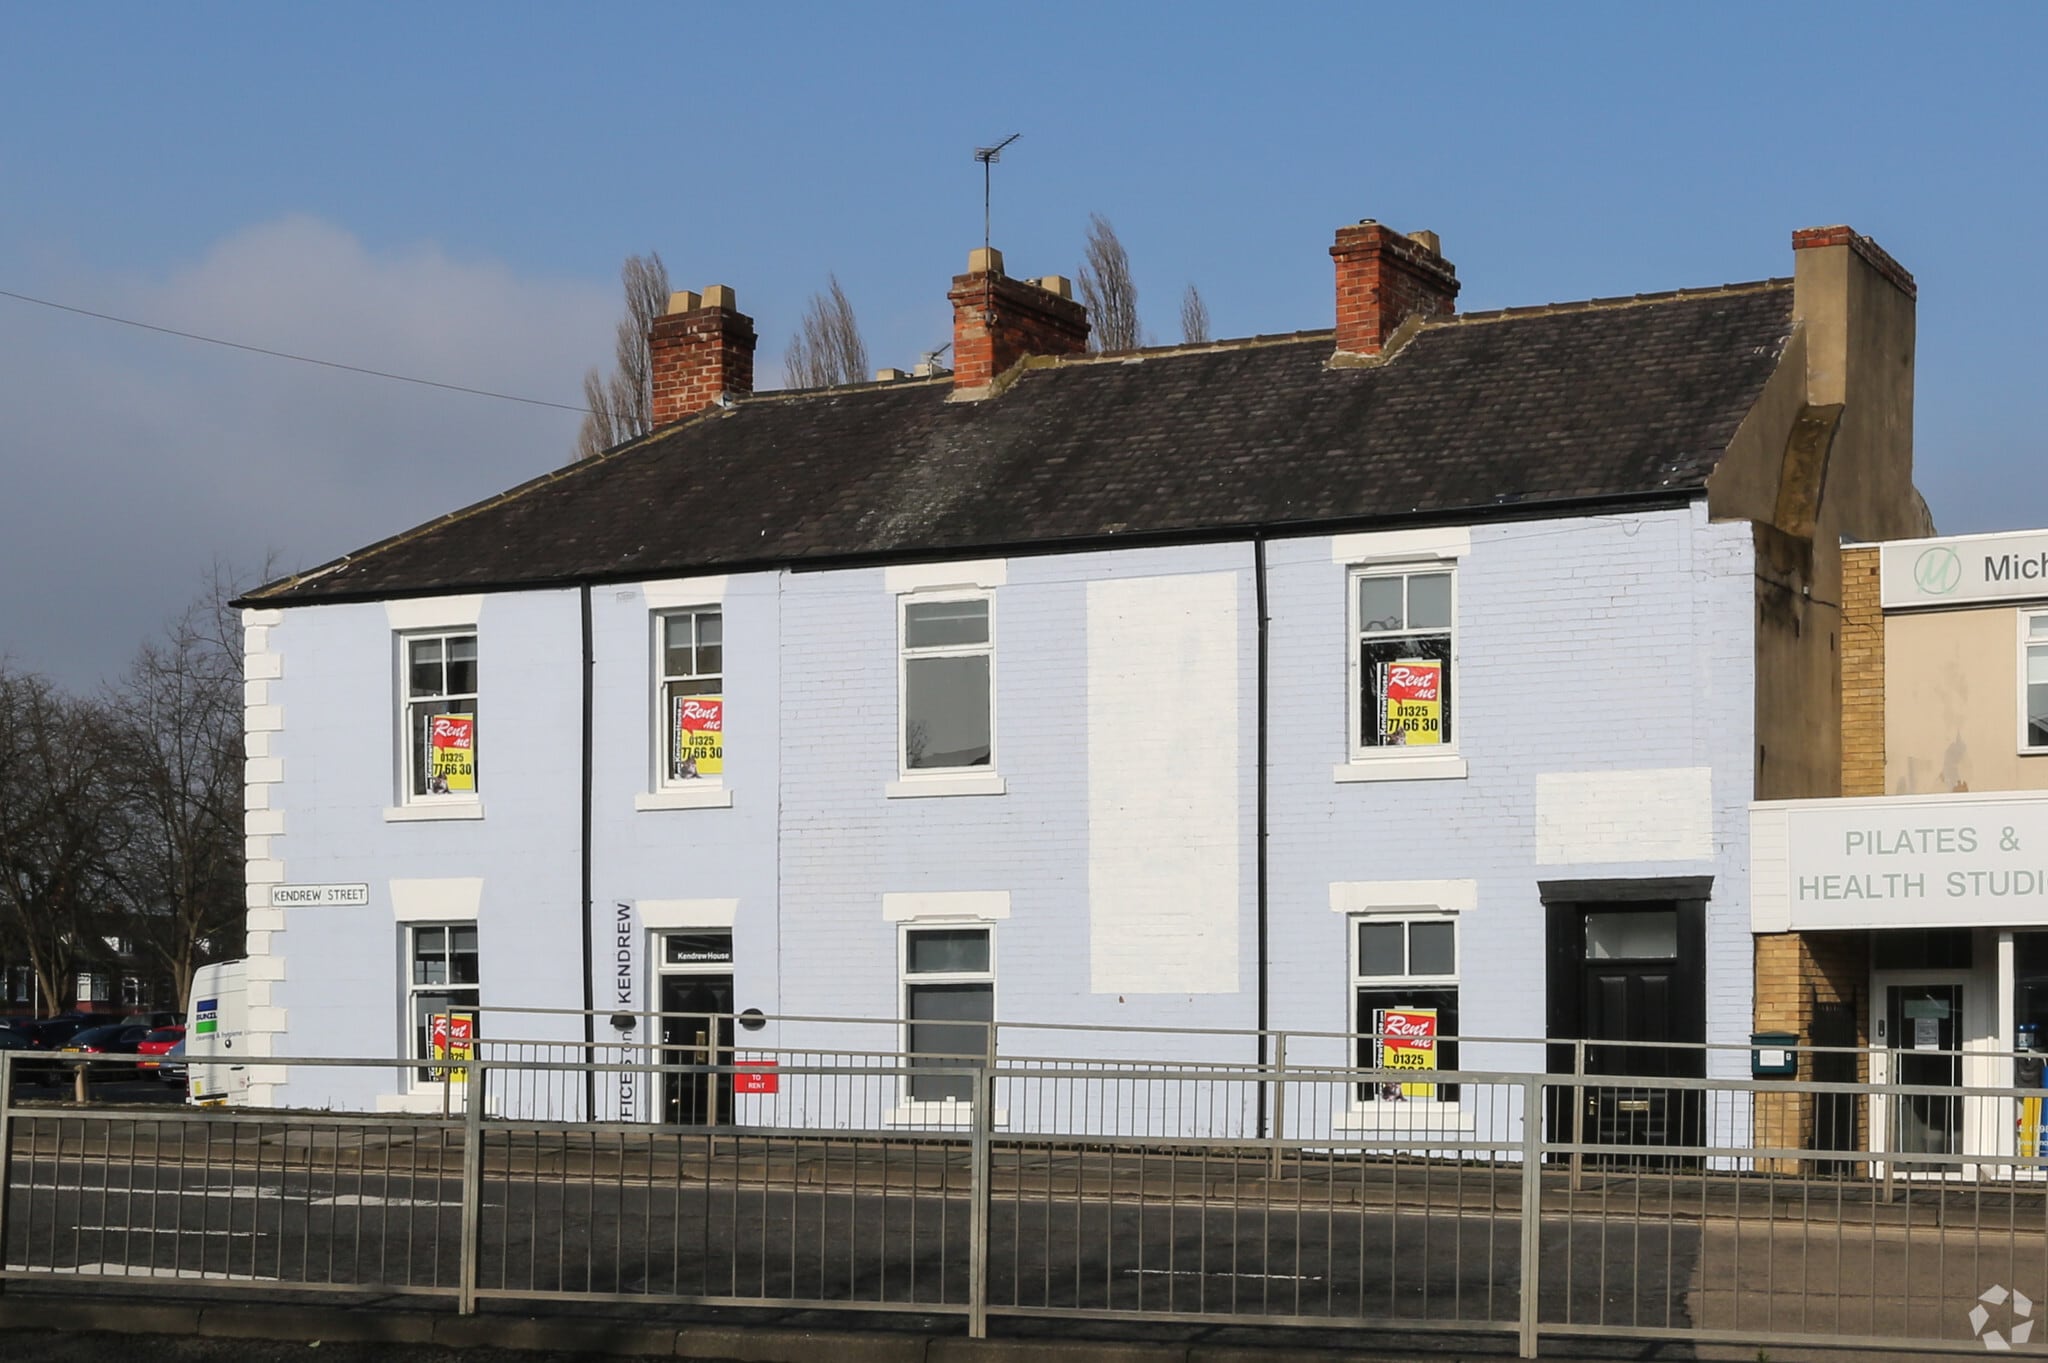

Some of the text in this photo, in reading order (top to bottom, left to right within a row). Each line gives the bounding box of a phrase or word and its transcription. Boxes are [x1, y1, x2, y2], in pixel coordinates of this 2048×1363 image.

[1389, 667, 1434, 688] Rent
[1415, 688, 1436, 699] me
[683, 701, 719, 719] Rent
[1397, 705, 1429, 717] 01325
[433, 719, 468, 737] Rent
[702, 720, 721, 730] me
[1403, 719, 1419, 732] 66
[1422, 718, 1438, 732] 30
[453, 737, 470, 747] me
[688, 735, 715, 746] 01325
[440, 752, 465, 762] 01325
[694, 747, 707, 759] 66
[709, 747, 723, 759] 30
[445, 763, 457, 775] 66
[459, 763, 472, 775] 30
[1845, 825, 2021, 855] PILATES &
[1798, 869, 2048, 900] HEALTH STUDI
[273, 888, 365, 902] KENDREW STREET
[617, 903, 631, 1004] KENDREW
[434, 1019, 467, 1037] Rnt
[1385, 1015, 1430, 1036] Rent
[1393, 1054, 1424, 1065] 01325
